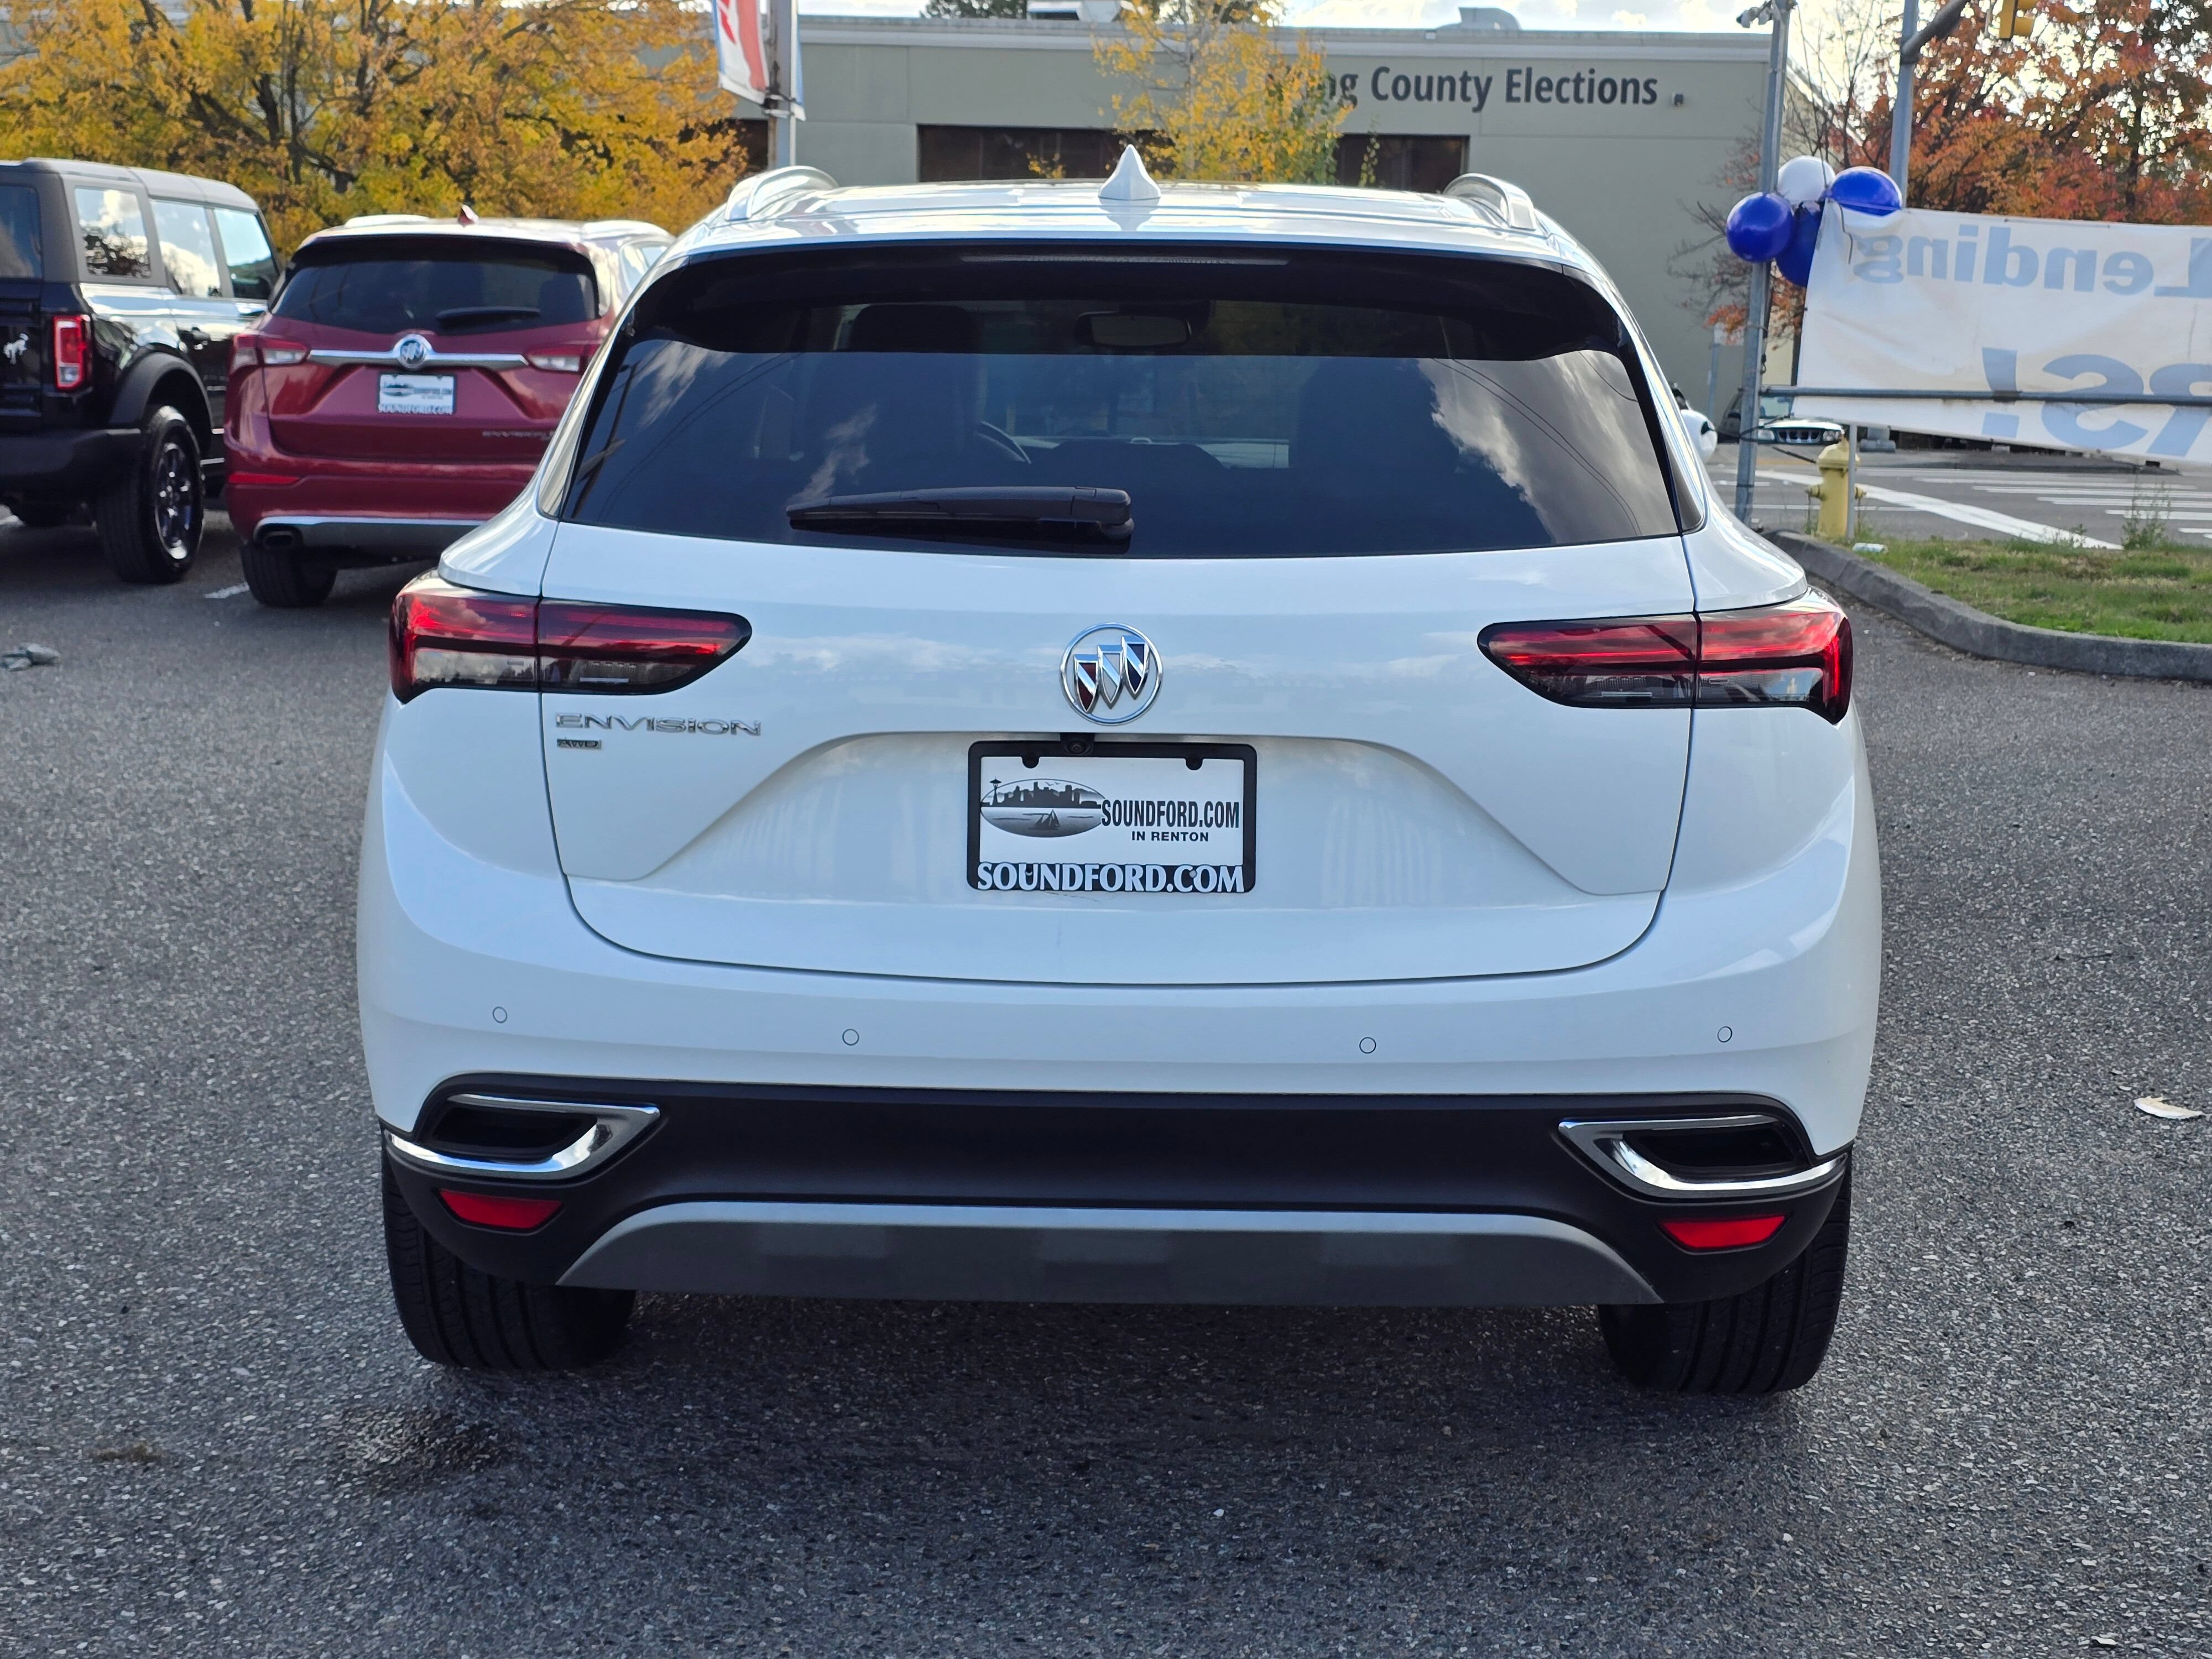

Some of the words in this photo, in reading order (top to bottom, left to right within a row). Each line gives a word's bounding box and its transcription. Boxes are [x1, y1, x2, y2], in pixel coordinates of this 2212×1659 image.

[1370, 65, 1493, 112] County
[1505, 66, 1658, 106] Elections
[556, 712, 761, 737] ENVISION
[557, 738, 602, 749] AWD
[1100, 799, 1240, 829] SOUNDFORD.COM
[1131, 830, 1146, 842] IN
[1151, 831, 1209, 842] RENTON
[977, 862, 1244, 893] SOUNDFORD.COM
